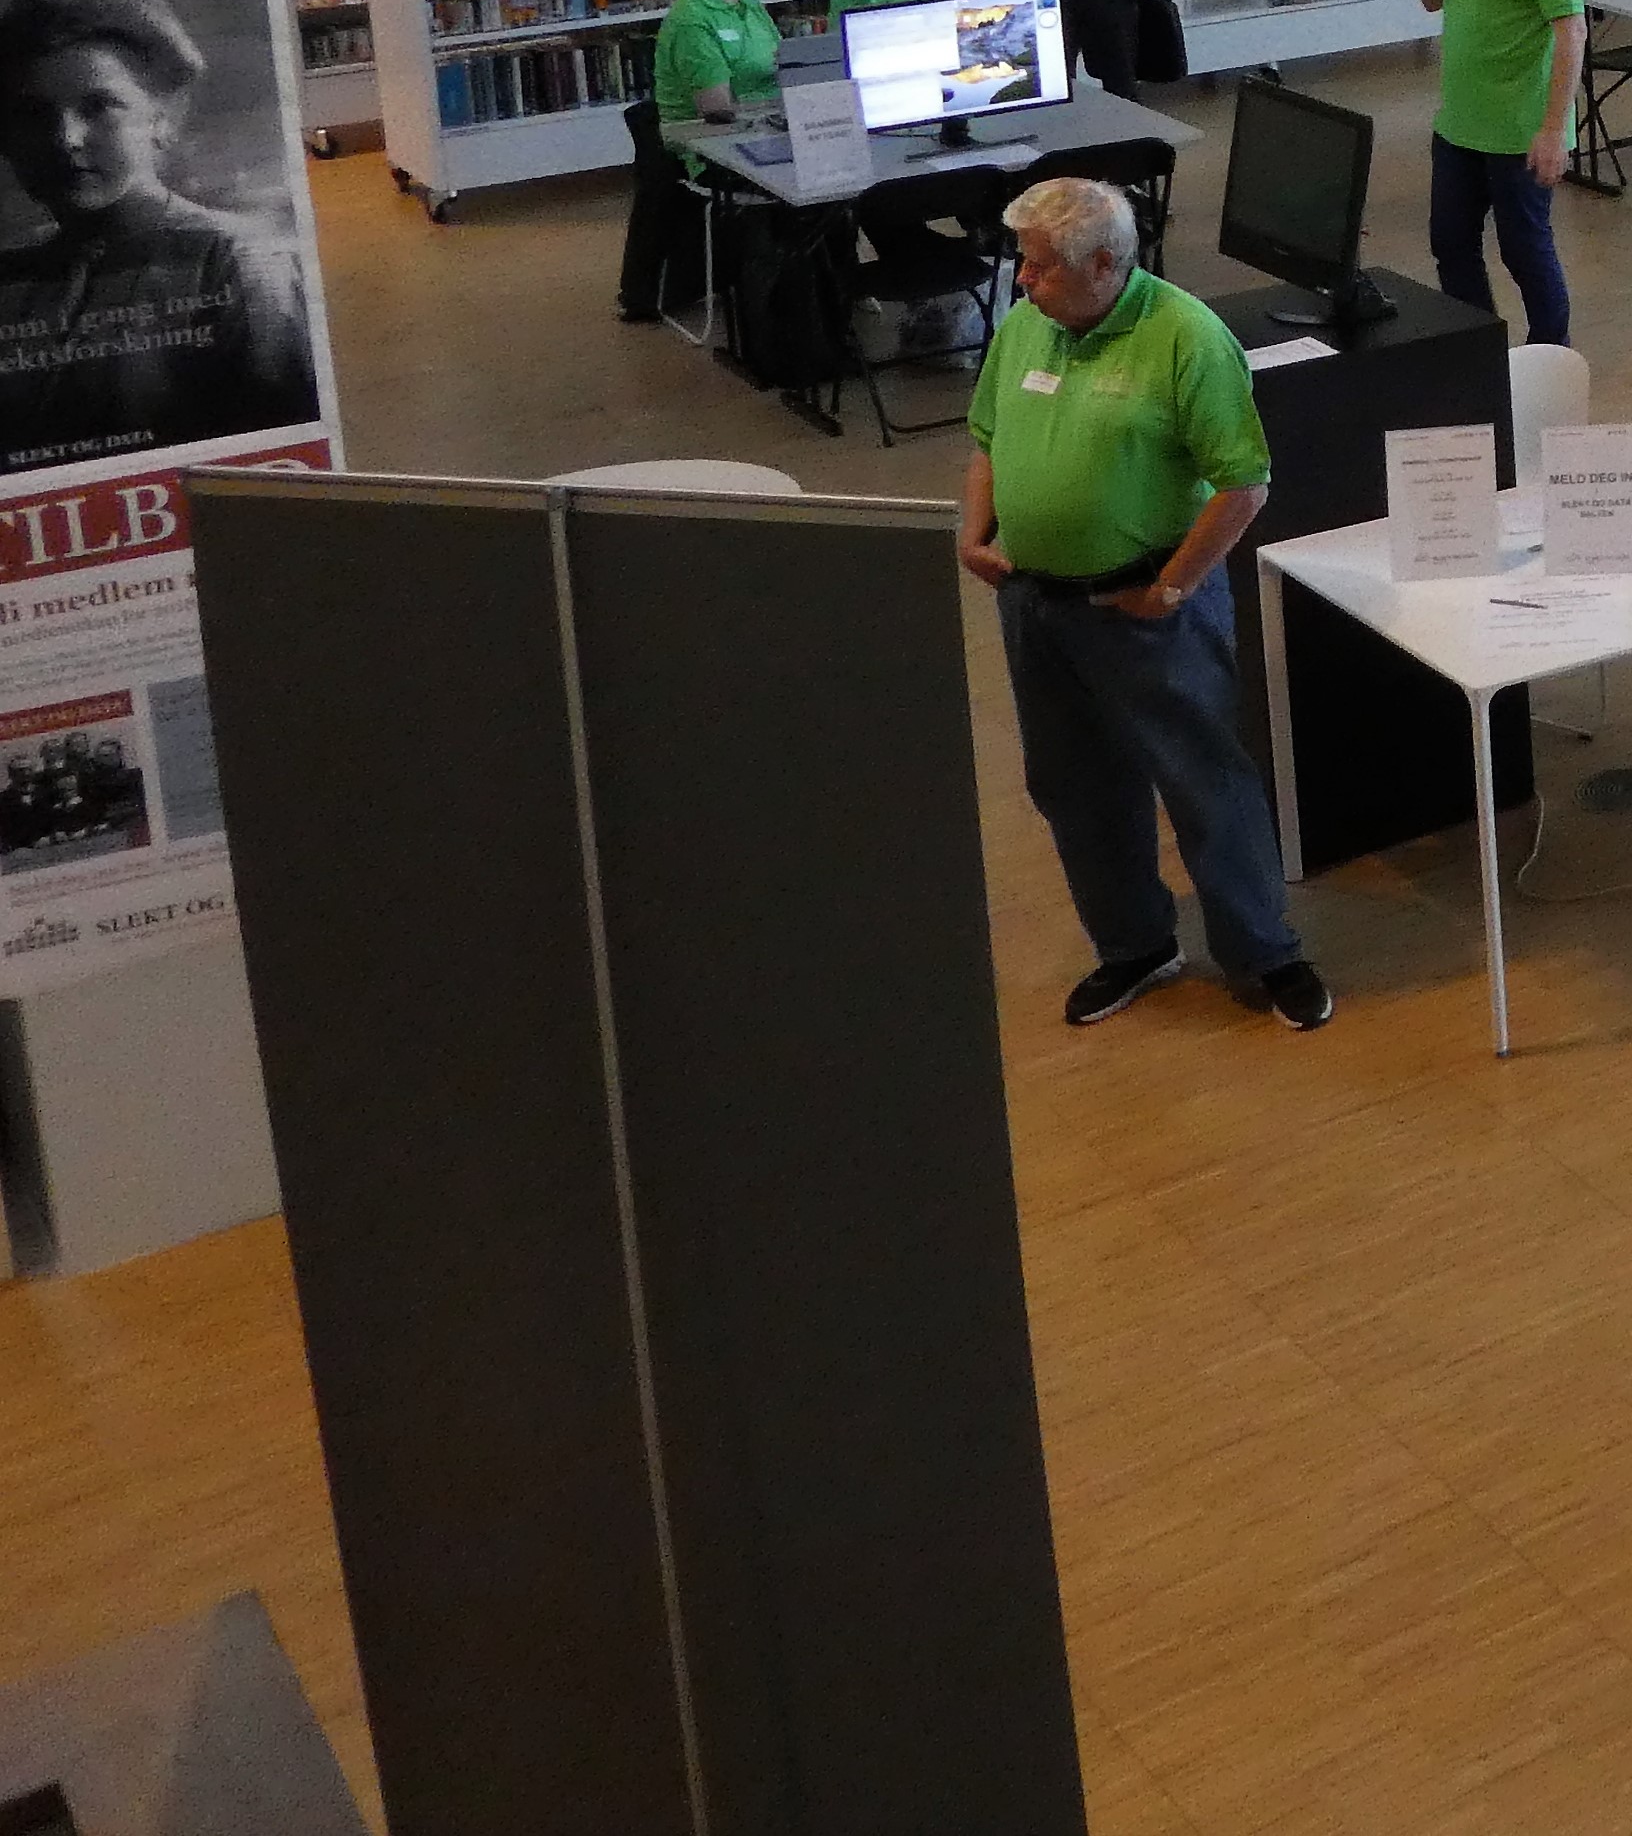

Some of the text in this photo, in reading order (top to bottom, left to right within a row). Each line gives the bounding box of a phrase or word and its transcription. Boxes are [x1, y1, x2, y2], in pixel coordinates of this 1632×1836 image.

[0, 318, 50, 340] om
[0, 324, 215, 374] ektsforskning
[1549, 474, 1586, 485] MELD
[1589, 472, 1617, 484] DEG
[0, 483, 178, 565] ILB
[32, 576, 174, 619] medlem
[96, 902, 178, 933] SLEKT
[185, 894, 224, 914] OG
